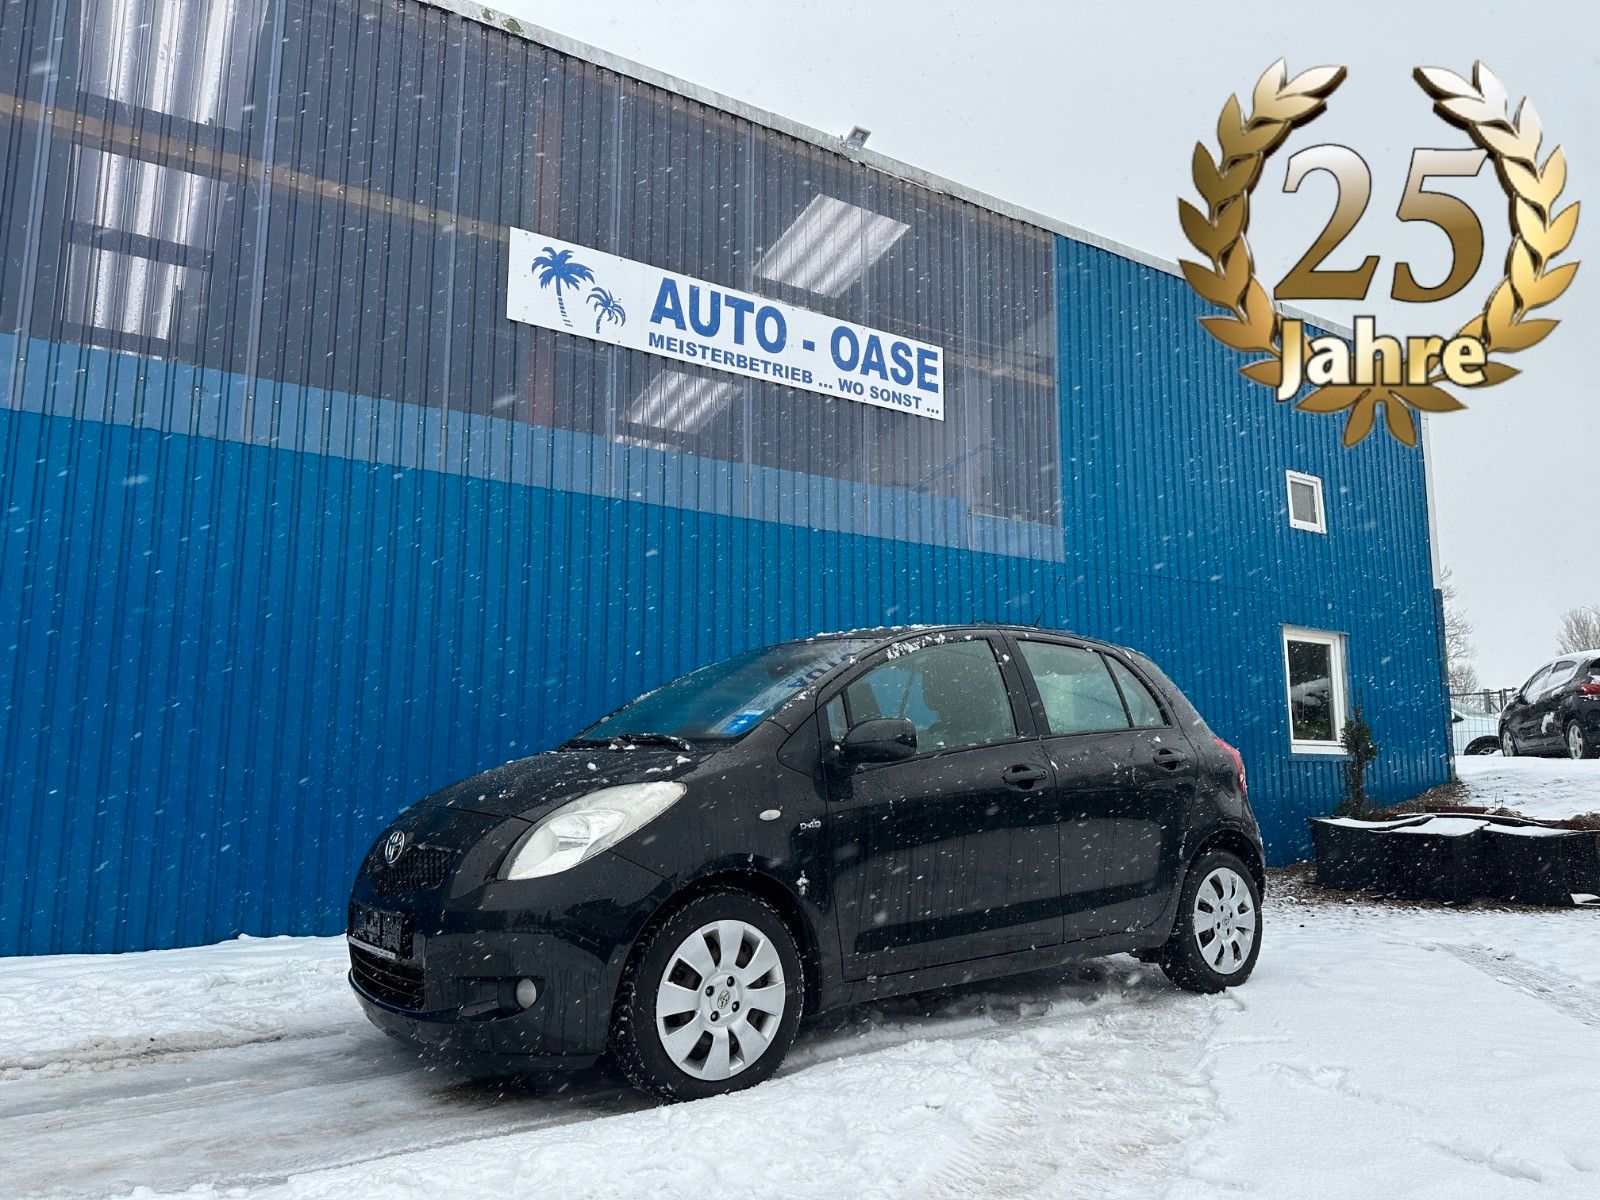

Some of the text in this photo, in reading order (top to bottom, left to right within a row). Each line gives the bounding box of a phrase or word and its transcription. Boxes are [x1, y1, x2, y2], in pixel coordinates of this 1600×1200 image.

[648, 332, 813, 384] MEISTERBETRIEB
[838, 378, 865, 396] WO
[869, 386, 922, 410] SONST
[650, 277, 787, 354] AUTO
[830, 325, 939, 393] OASE
